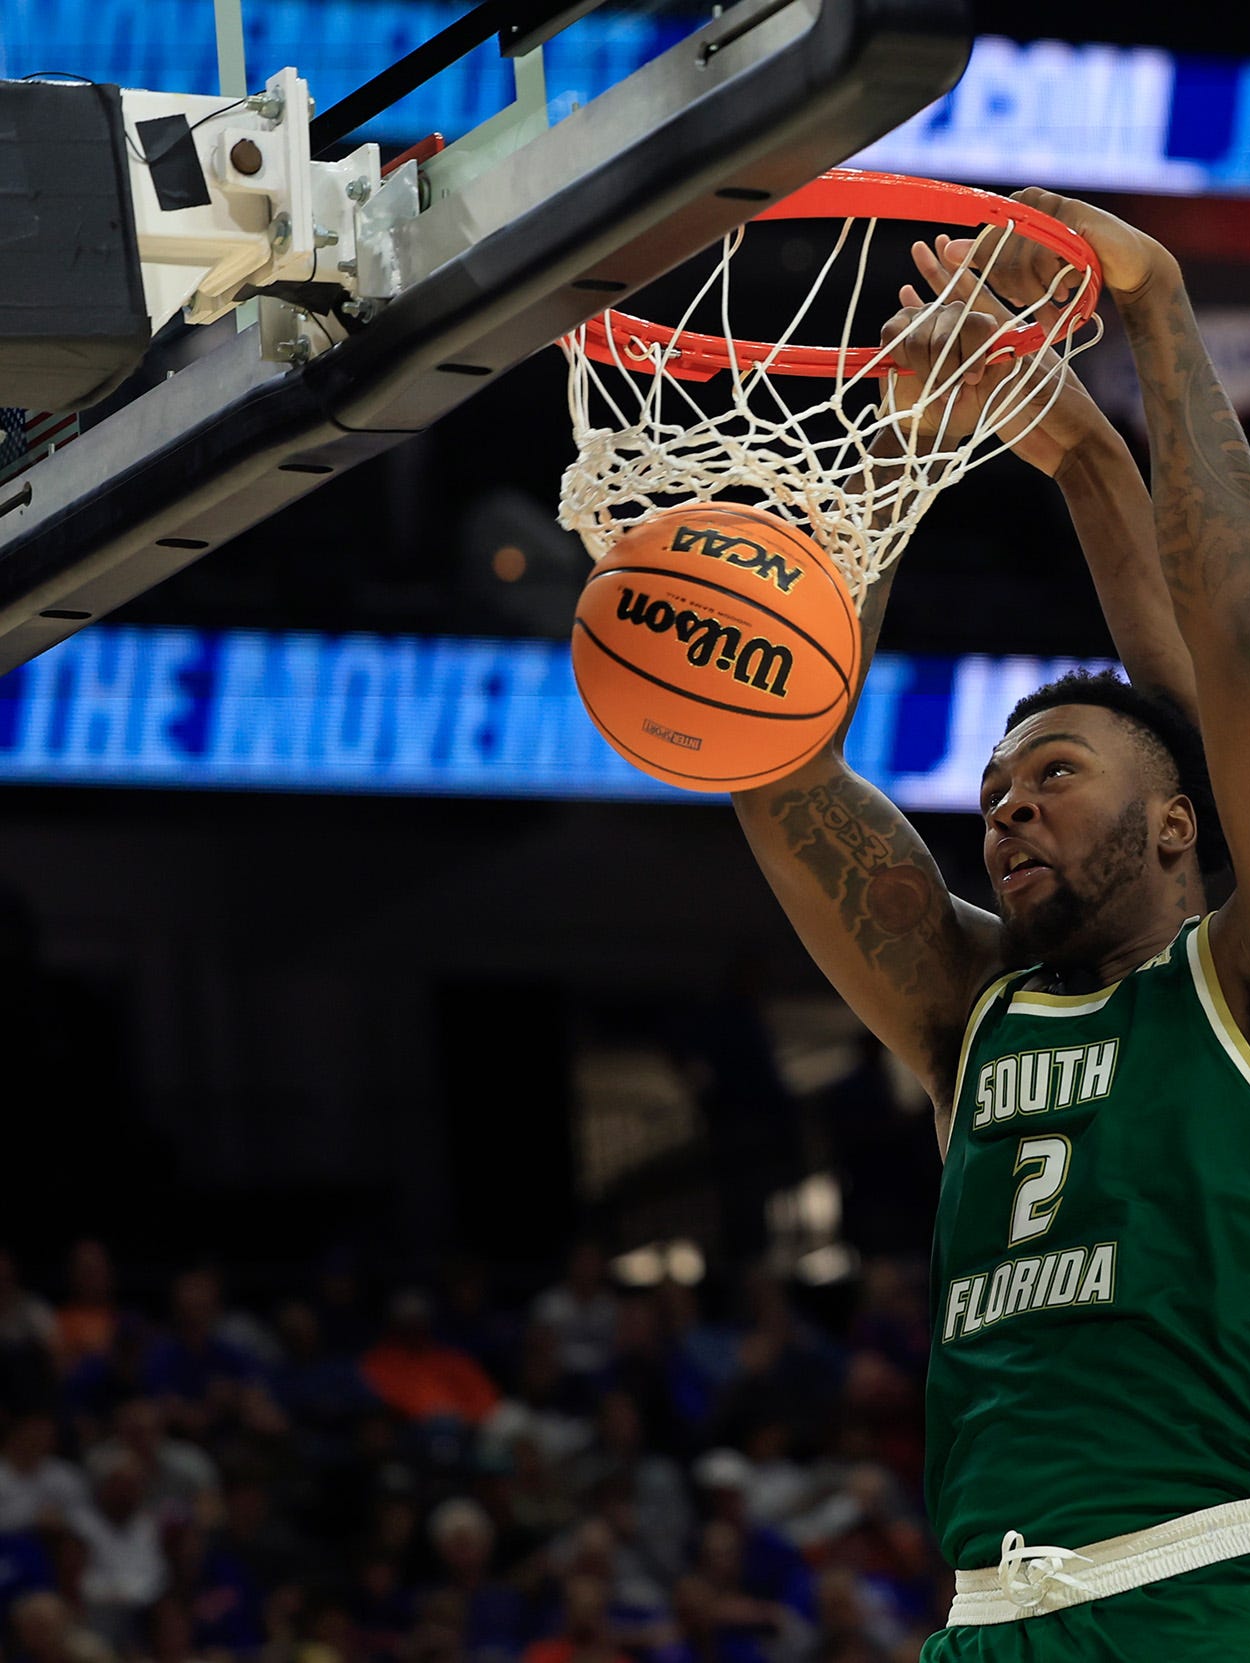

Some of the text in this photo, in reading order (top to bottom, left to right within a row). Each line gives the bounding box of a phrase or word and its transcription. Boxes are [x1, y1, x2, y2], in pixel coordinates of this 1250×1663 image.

[671, 526, 804, 595] NCAA
[616, 587, 794, 697] Wilson
[22, 625, 203, 772] THE
[973, 1038, 1120, 1131] SOUTH
[1008, 1134, 1072, 1248] 2
[942, 1241, 1117, 1344] FLORIDA
